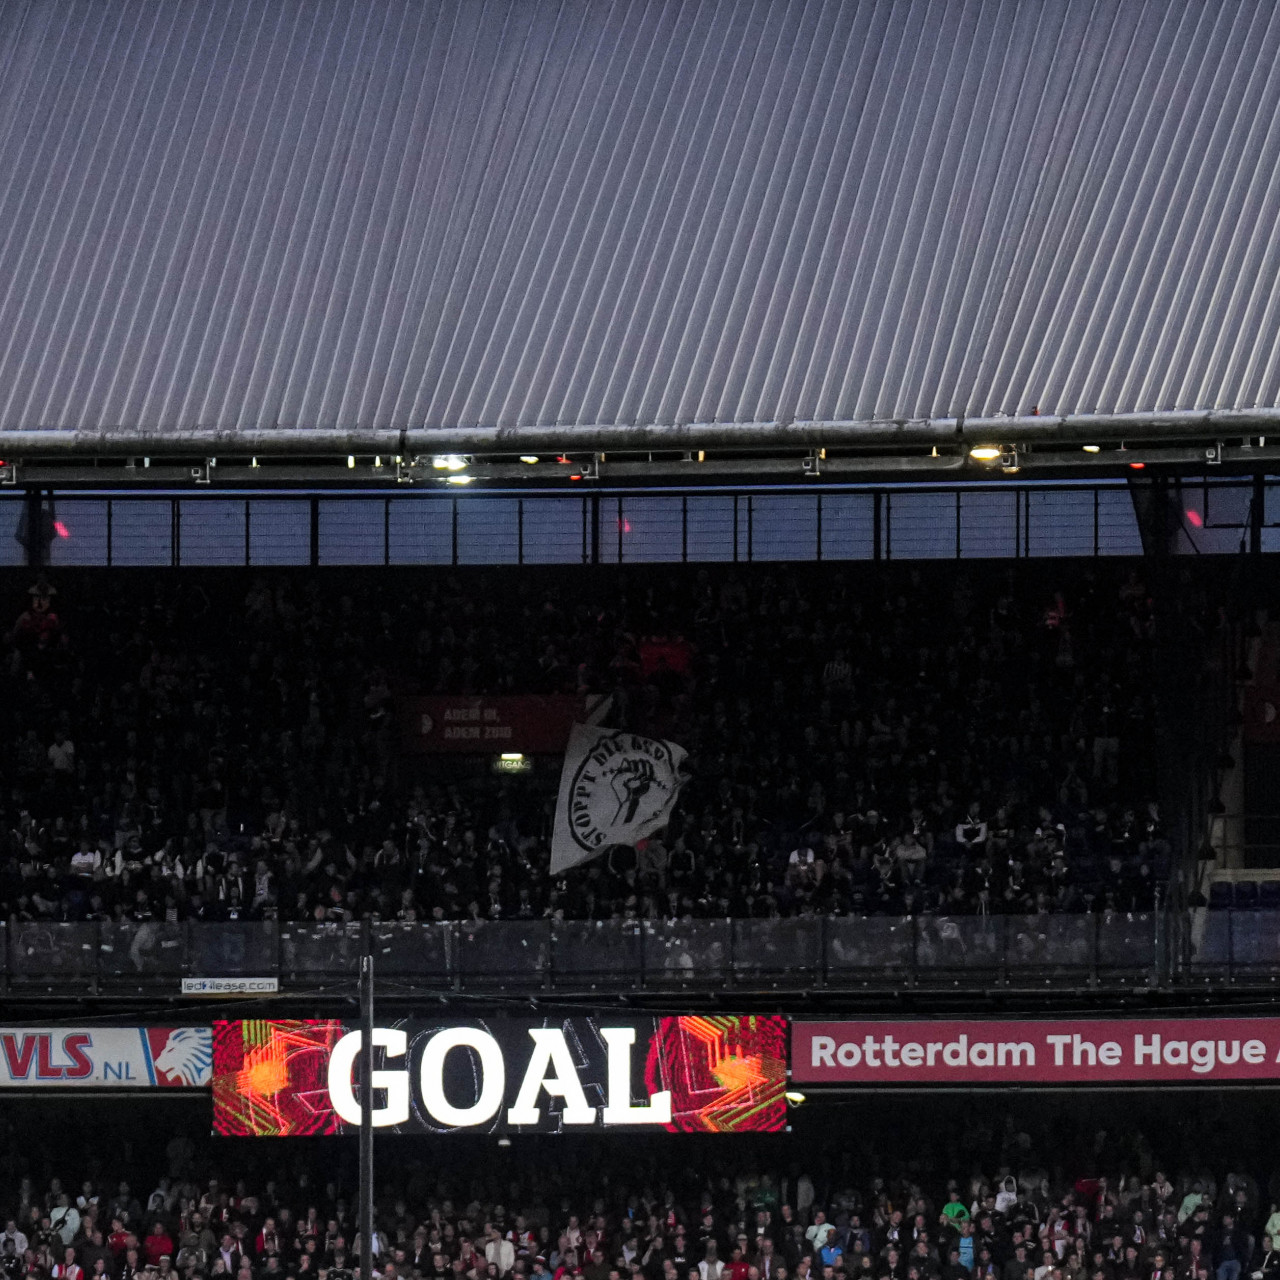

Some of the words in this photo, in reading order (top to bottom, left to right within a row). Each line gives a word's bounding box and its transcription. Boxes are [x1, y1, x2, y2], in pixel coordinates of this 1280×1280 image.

[327, 1026, 673, 1128] GOAL
[810, 1034, 1036, 1068] Rotterdam
[1046, 1033, 1124, 1067] The
[1133, 1030, 1267, 1074] Hague
